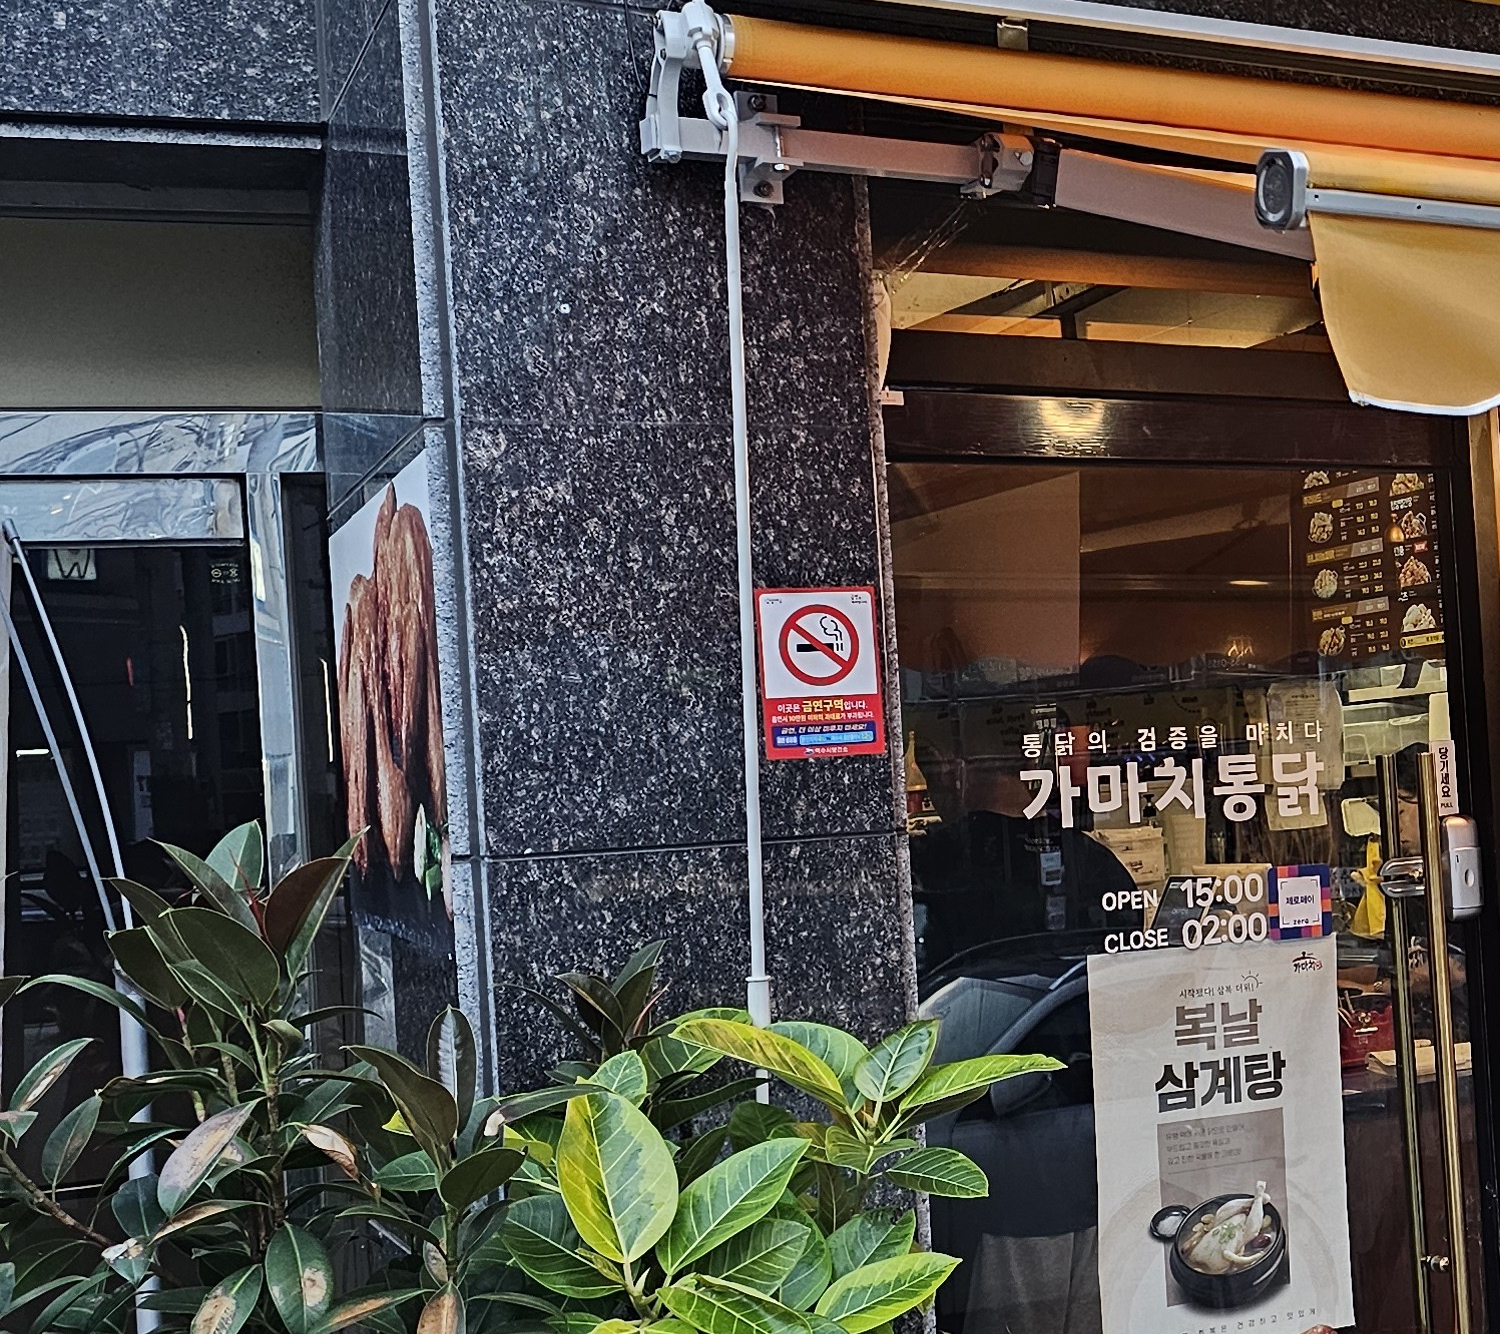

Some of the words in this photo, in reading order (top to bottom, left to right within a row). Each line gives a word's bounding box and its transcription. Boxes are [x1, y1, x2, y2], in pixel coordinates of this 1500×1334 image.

[1021, 729, 1109, 758] 통닭의
[1137, 724, 1219, 752] 검증을
[1246, 720, 1323, 746] 마치다
[1019, 750, 1325, 829] 가마치통닭
[1438, 747, 1451, 798] 당기세요
[1101, 889, 1158, 912] OPEN
[1179, 873, 1264, 908] 15:00
[1104, 927, 1169, 954] CLOSE
[1181, 912, 1268, 950] 02:00
[1174, 998, 1262, 1050] 복날
[1154, 1050, 1287, 1113] 삼계탕
